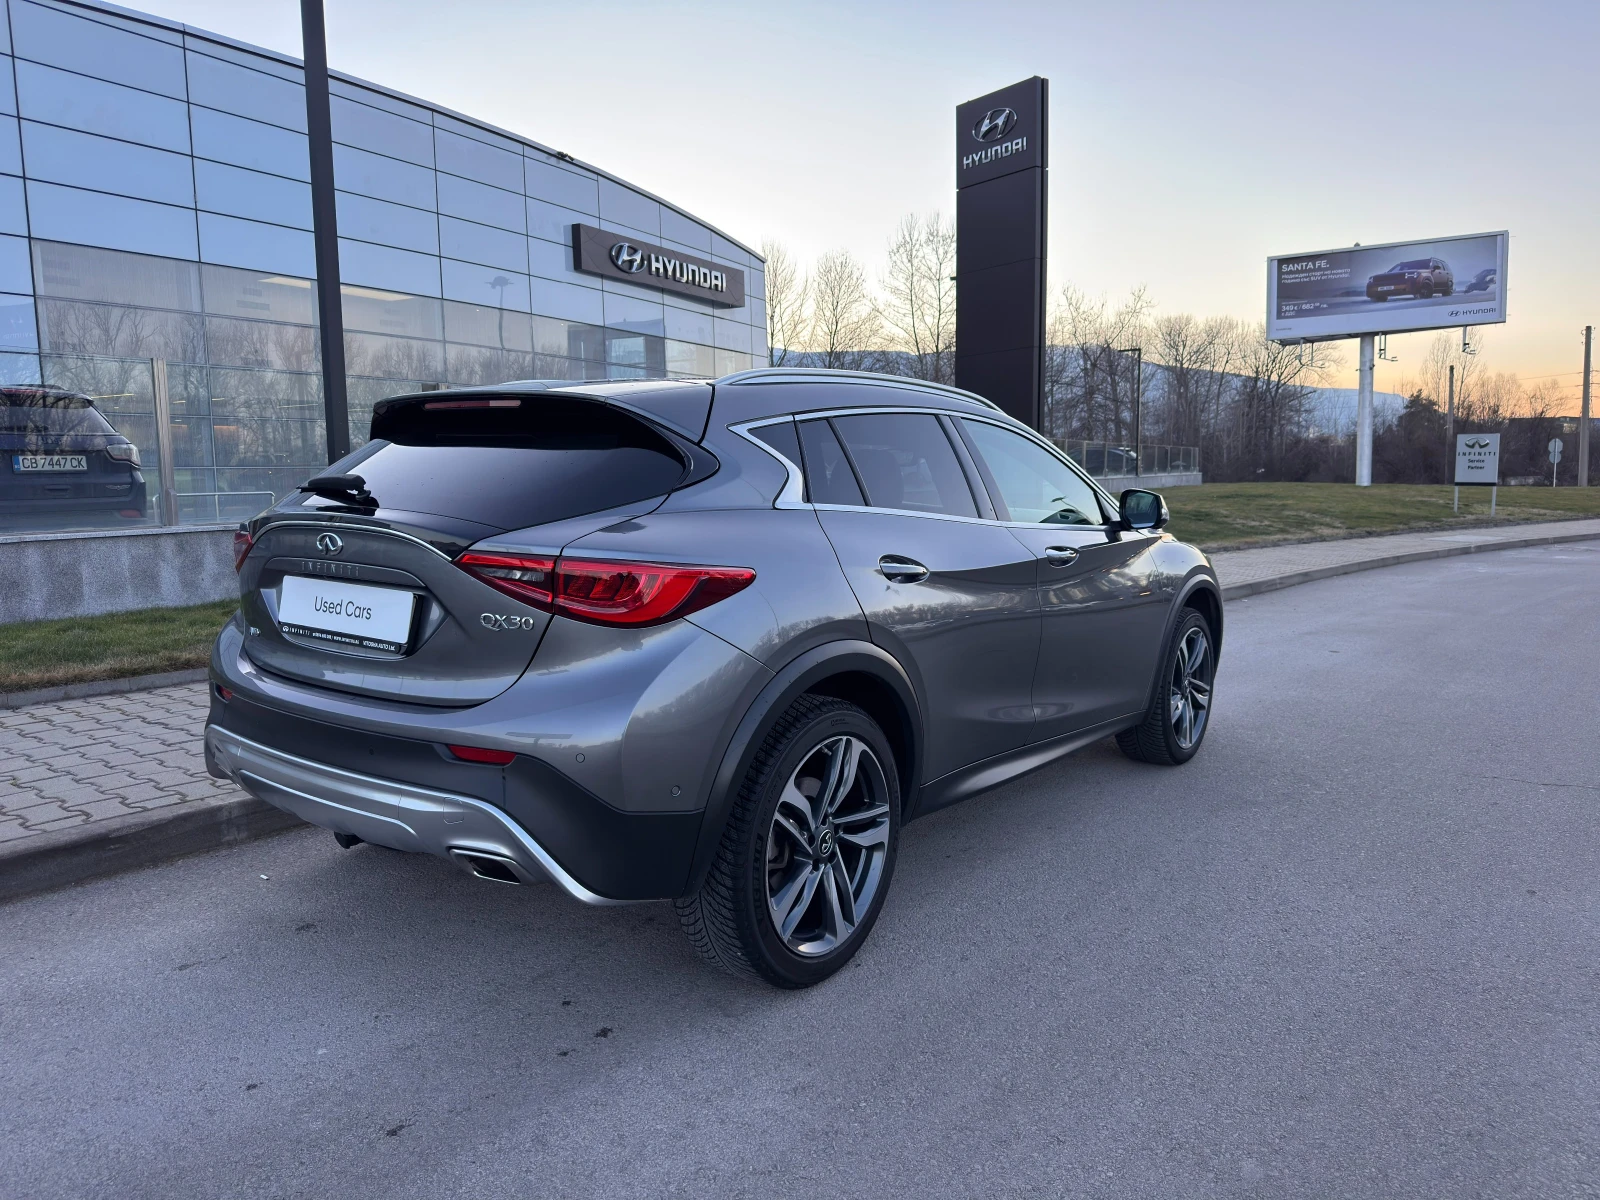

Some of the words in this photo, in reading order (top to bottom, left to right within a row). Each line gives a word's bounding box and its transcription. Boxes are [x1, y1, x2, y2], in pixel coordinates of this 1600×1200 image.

[963, 136, 1027, 170] HYUNDAI
[650, 253, 727, 293] HYUNDAI
[1281, 262, 1314, 272] SANTA
[1315, 260, 1330, 269] FE.
[1281, 304, 1294, 312] 349
[1462, 307, 1497, 316] HYUNDAI
[21, 457, 38, 469] CB
[39, 457, 68, 469] 7447
[70, 457, 85, 469] CK
[302, 561, 359, 577] INFINITI
[314, 596, 343, 616] Used
[345, 602, 373, 621] Cars
[480, 612, 534, 631] QX30
[289, 626, 310, 636] INFINITI
